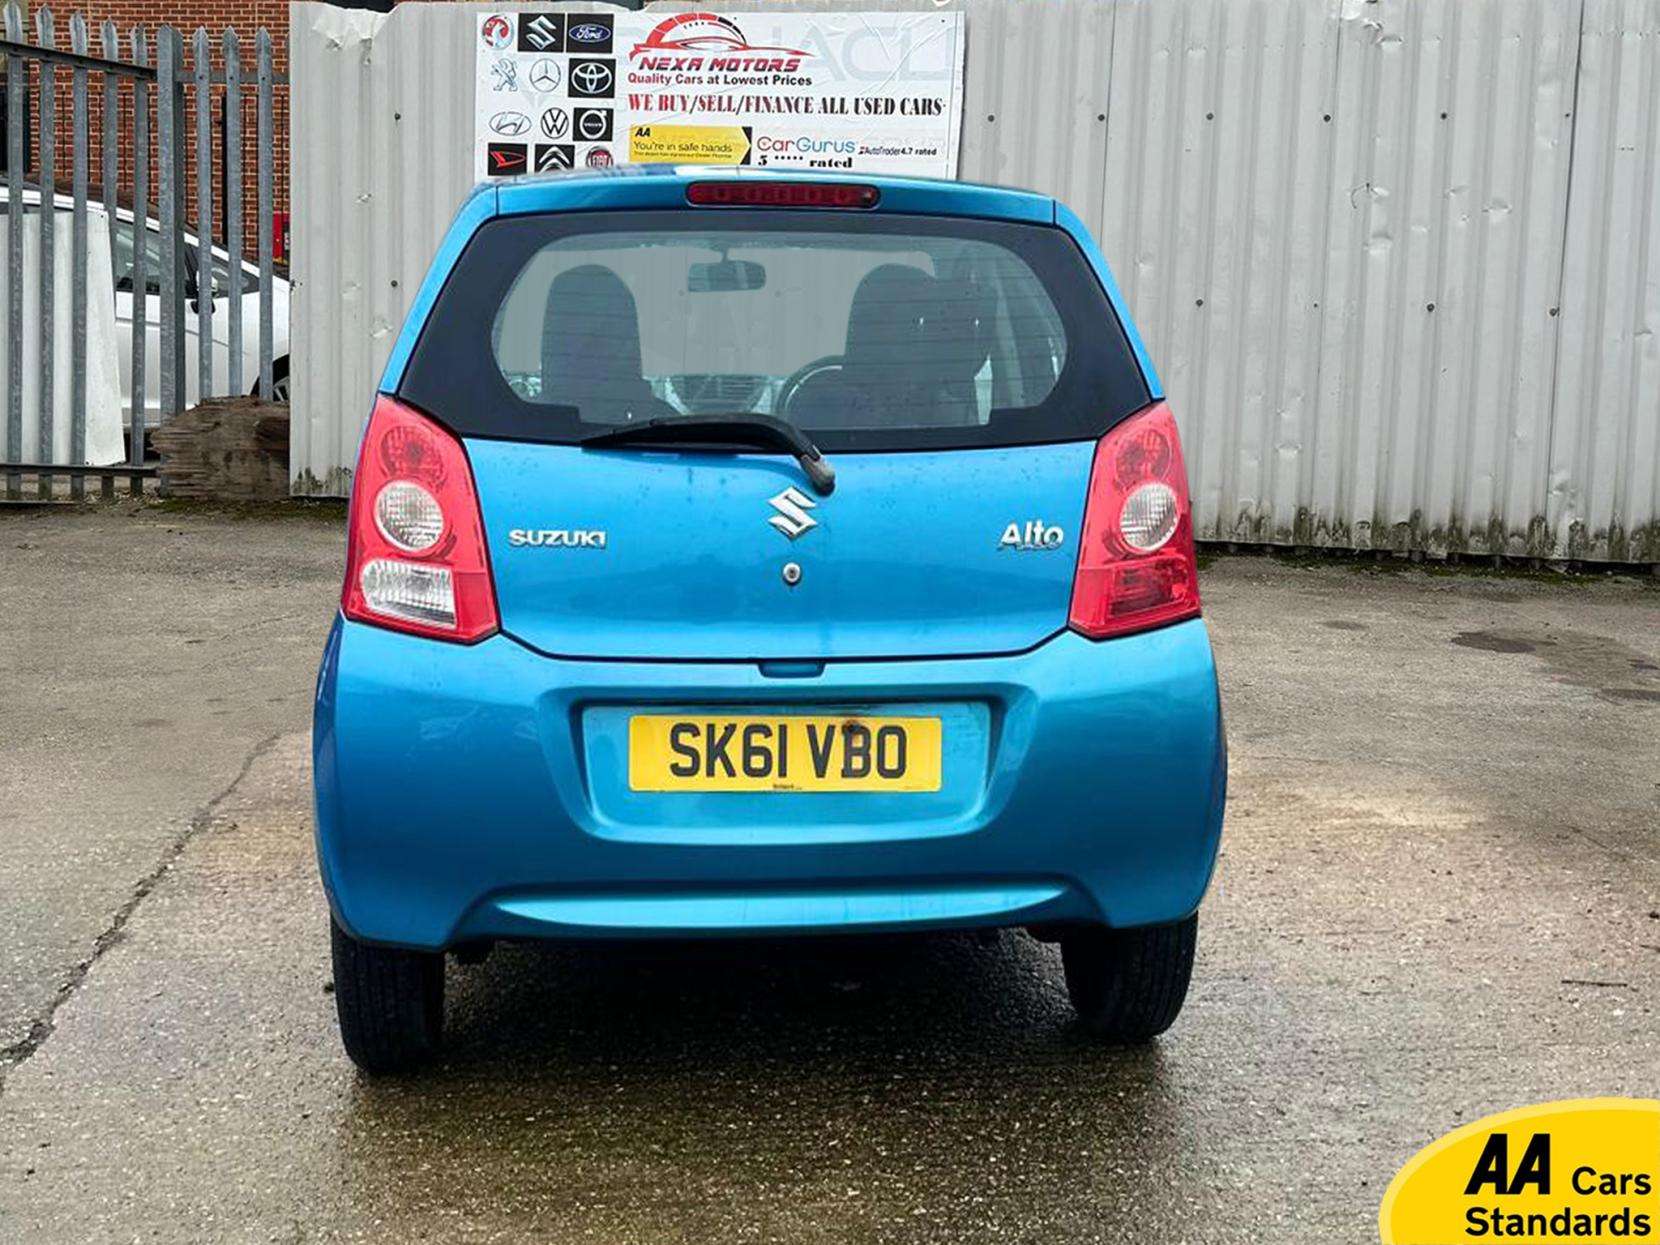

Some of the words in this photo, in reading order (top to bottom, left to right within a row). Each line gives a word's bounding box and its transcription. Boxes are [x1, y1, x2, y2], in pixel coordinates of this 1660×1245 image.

[638, 57, 705, 72] NEXA
[708, 58, 801, 72] MOTORS
[628, 72, 672, 86] Quality
[675, 74, 704, 85] Cars
[707, 75, 720, 85] at
[723, 75, 769, 86] Lowest
[772, 76, 813, 86] Prices
[628, 94, 653, 111] WE
[657, 94, 814, 115] BUY/SELL/FINANCE
[818, 97, 849, 114] ALL
[854, 97, 896, 115] USED
[900, 97, 943, 116] CARS
[635, 127, 651, 137] AA
[633, 141, 665, 152] You're
[667, 142, 676, 151] in
[678, 142, 698, 152] safe
[701, 142, 733, 153] hands
[756, 136, 856, 153] CarGurus
[915, 148, 937, 156] rated
[757, 155, 768, 166] 5
[809, 157, 853, 168] rated
[508, 529, 606, 549] SUZUKI
[1000, 519, 1064, 549] Alto
[669, 722, 788, 778] SK61
[806, 722, 908, 779] VBO
